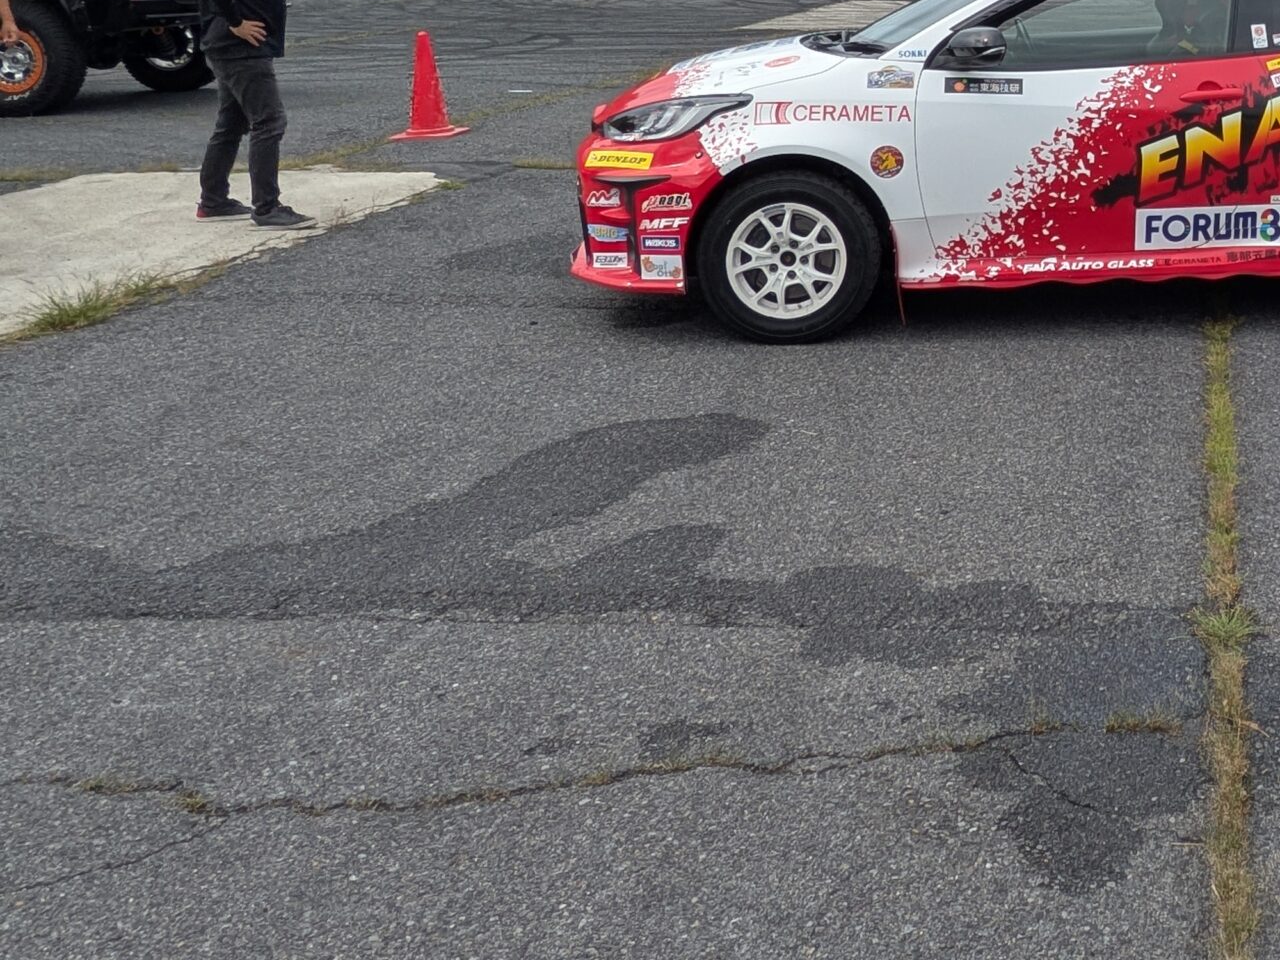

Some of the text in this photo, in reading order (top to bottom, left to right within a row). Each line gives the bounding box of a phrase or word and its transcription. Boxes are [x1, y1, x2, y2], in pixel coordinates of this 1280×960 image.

[793, 104, 911, 123] CERAMETA
[598, 155, 648, 165] DUNLOP
[639, 217, 689, 230] MFF
[1145, 208, 1280, 243] FORUM8
[1058, 260, 1105, 271] AUTO
[1107, 258, 1155, 269] GLASS
